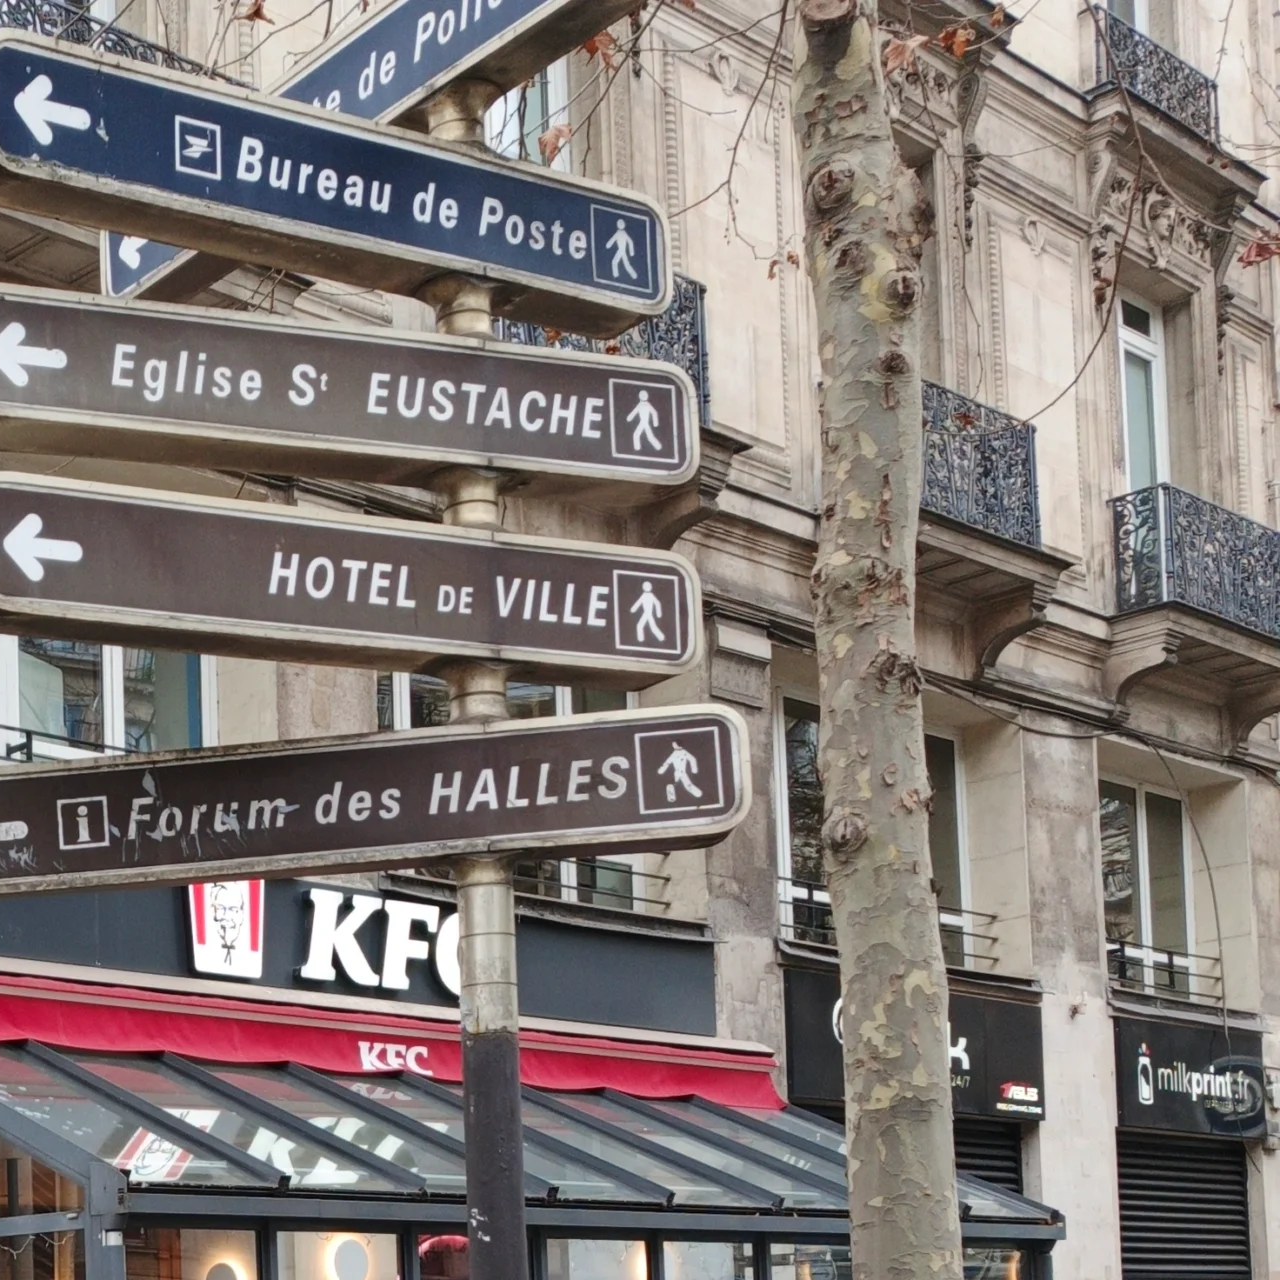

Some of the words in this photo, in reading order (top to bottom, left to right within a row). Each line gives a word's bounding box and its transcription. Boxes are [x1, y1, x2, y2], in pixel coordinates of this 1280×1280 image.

[358, 49, 397, 101] de
[235, 135, 393, 214] Bureau
[412, 181, 459, 229] de
[478, 196, 588, 260] Poste
[111, 342, 263, 402] Eglise
[288, 363, 329, 406] St
[366, 372, 605, 439] EUSTACHE
[268, 550, 417, 609] HOTEL
[437, 583, 474, 615] DE
[496, 574, 610, 627] VILLE
[127, 796, 288, 841] Forum
[314, 781, 402, 825] des
[428, 755, 630, 815] HALLES
[357, 1040, 434, 1077] KFC
[1157, 1061, 1250, 1102] milkprint.fr
